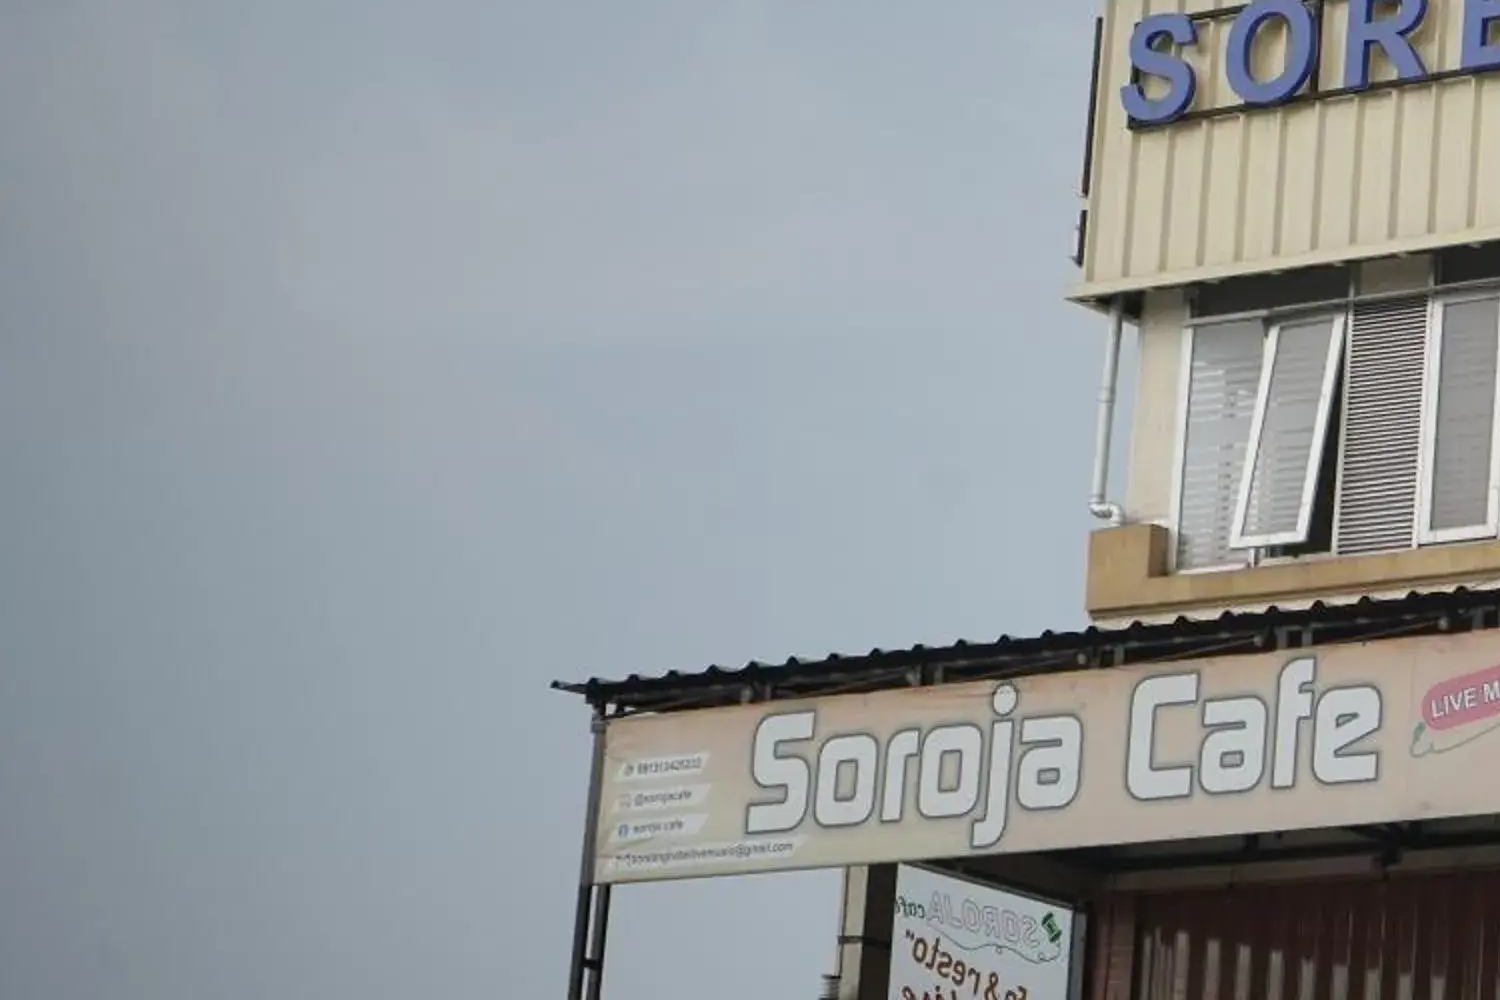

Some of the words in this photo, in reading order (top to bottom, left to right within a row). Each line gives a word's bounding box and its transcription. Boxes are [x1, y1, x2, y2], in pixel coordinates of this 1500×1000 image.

[745, 681, 1084, 849] Soroja
[1125, 656, 1382, 801] Cafe
[1430, 687, 1478, 719] LIVE
